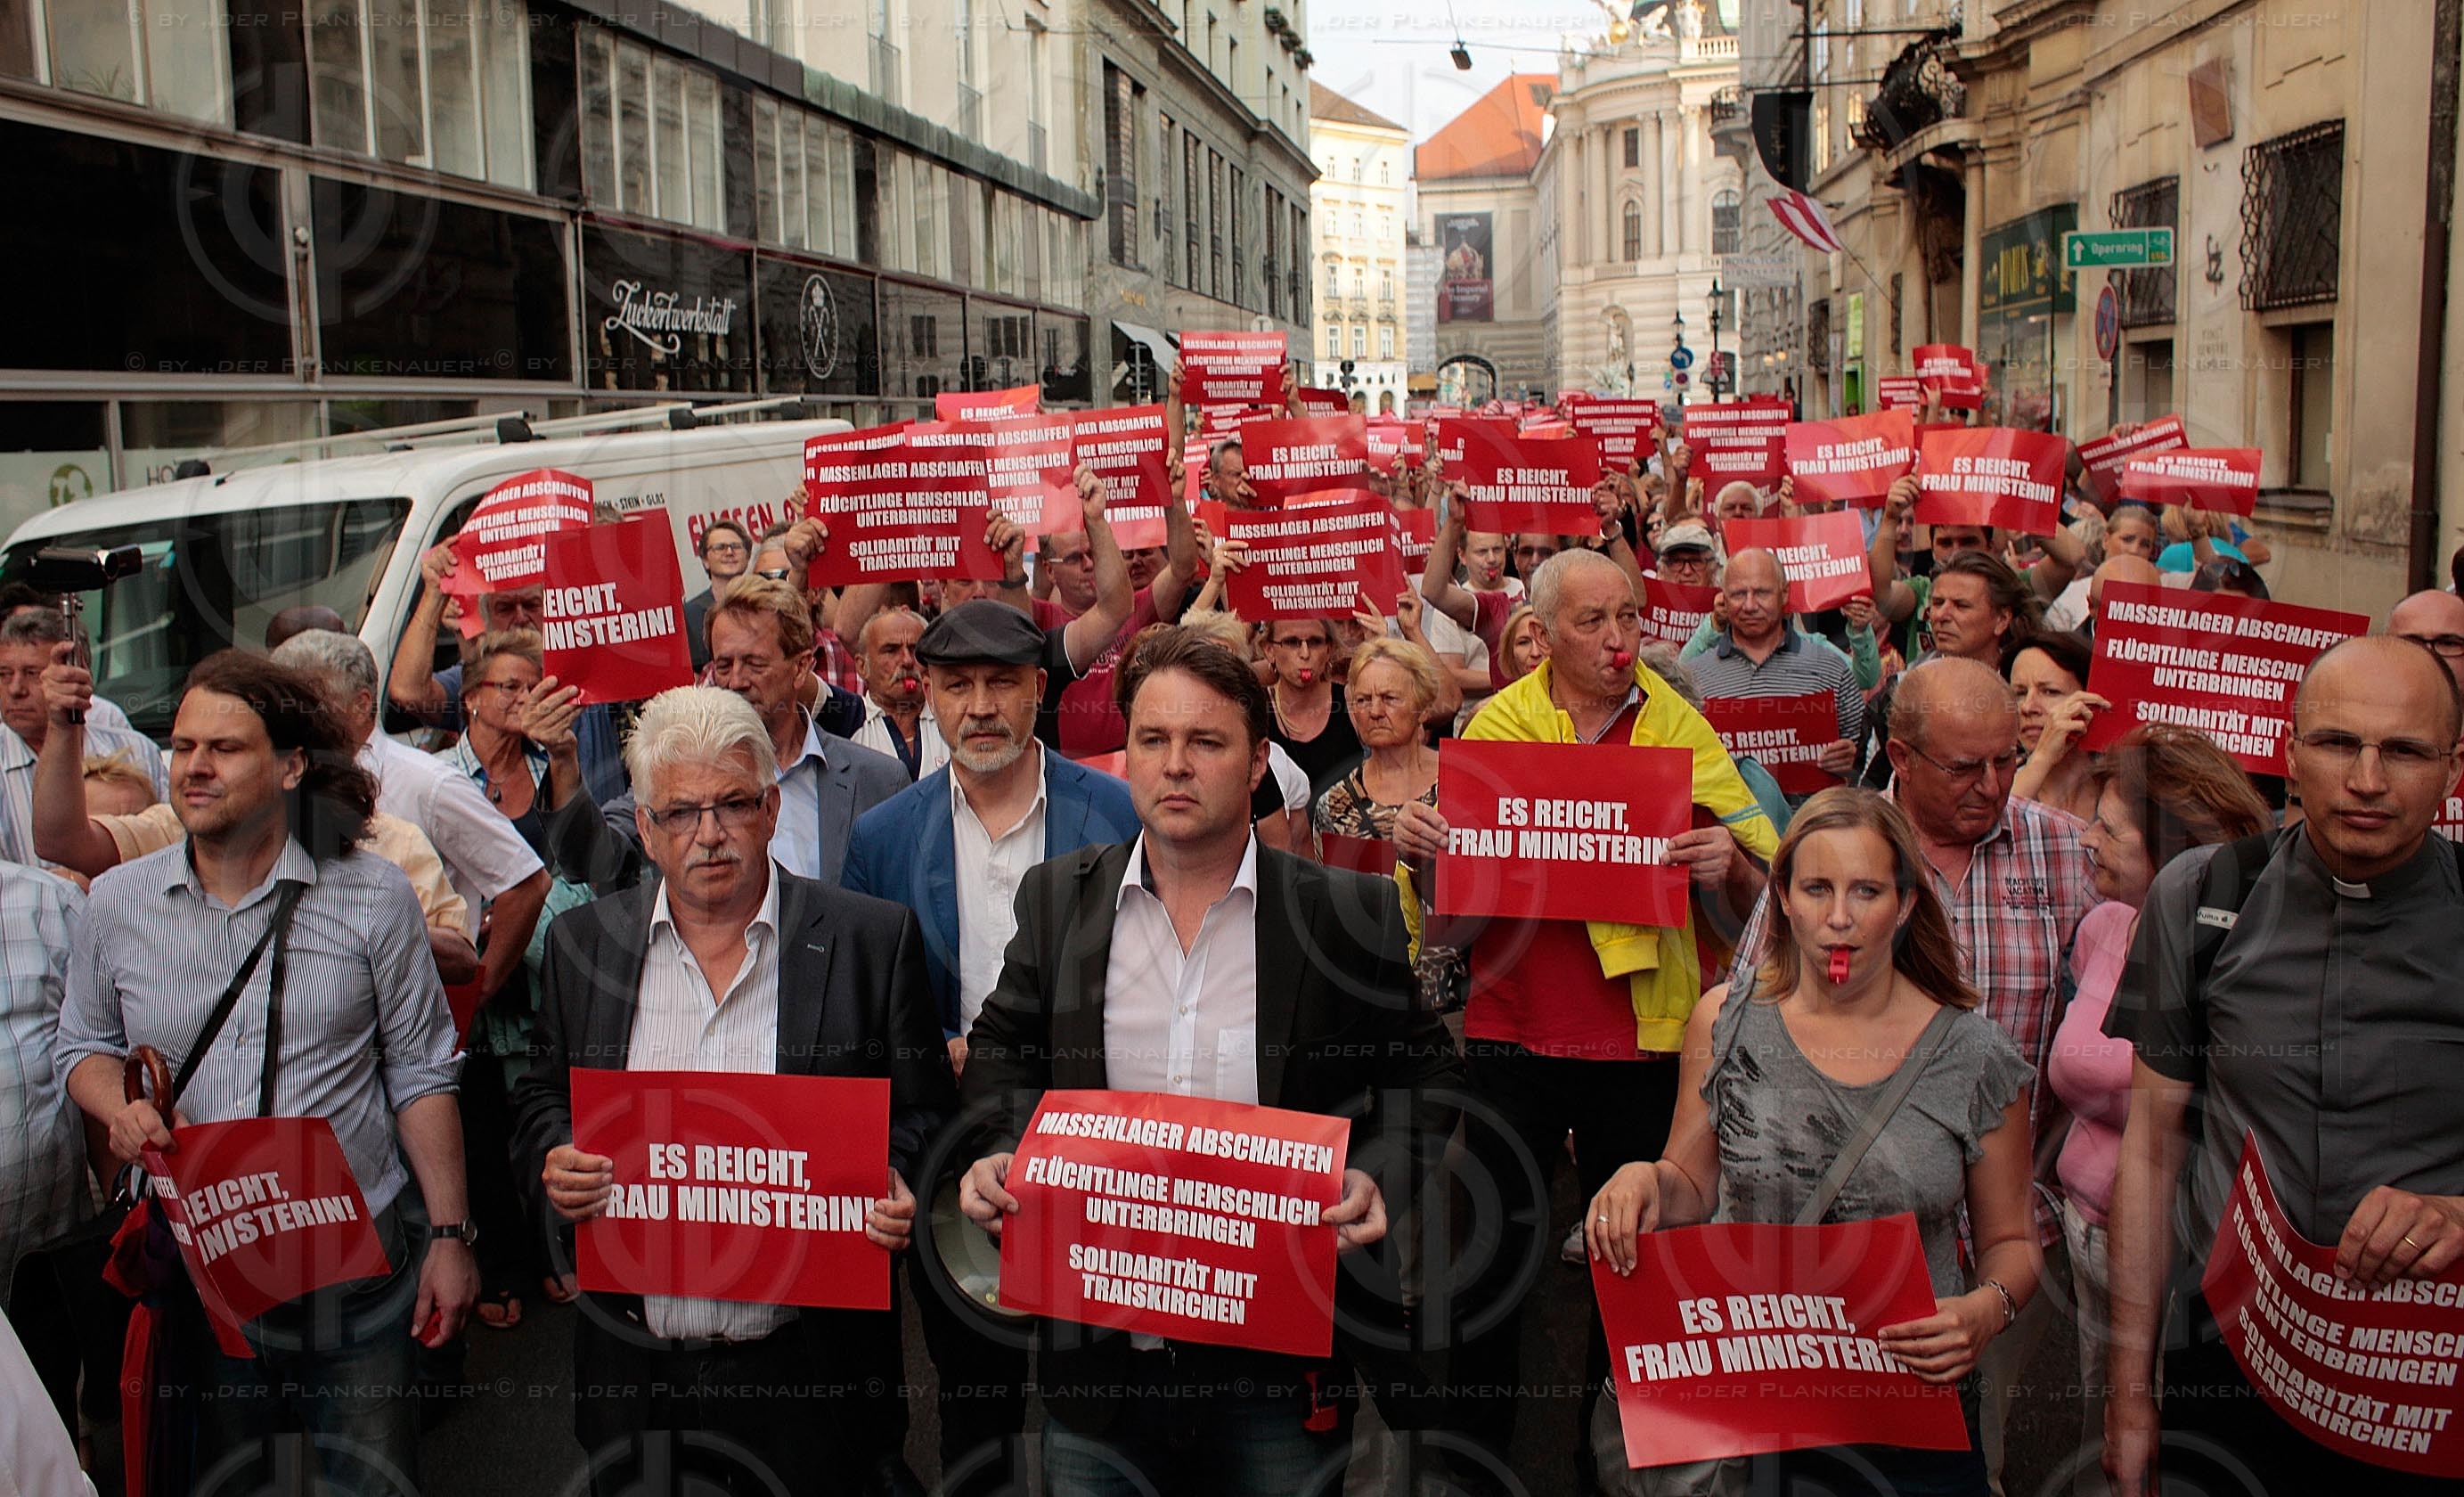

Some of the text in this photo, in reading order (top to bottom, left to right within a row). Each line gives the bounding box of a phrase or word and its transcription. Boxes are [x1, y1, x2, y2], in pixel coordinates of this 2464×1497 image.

[997, 425, 1070, 446] ABSCHAFFEN
[1099, 415, 1163, 433] ABSCHAFFEN
[1098, 438, 1163, 457] MENSCHLICH
[1272, 444, 1338, 463] ES REICHT,
[1816, 437, 1885, 459] ES REICHT,
[820, 462, 908, 483] MASSENLAGER
[910, 460, 986, 478] ABSCHAFFEN
[994, 452, 1069, 473] MENSCHLICH
[1248, 462, 1282, 480] FRAU
[1792, 447, 1911, 475] FRAU MINISTERIN!
[1953, 457, 2030, 481] ES REICHT,
[989, 470, 1040, 488] BRINGEN
[1121, 475, 1140, 488] MIT
[1497, 468, 1570, 487] ES REICHT,
[2166, 464, 2255, 488] MINISTERIN!
[522, 480, 589, 503] ABSCHAFFEN
[820, 493, 903, 513] FLÜCHTLINGE
[905, 489, 989, 508] MENSCHLICH
[1470, 486, 1592, 503] FRAU MINISTERIN
[1921, 474, 2055, 504] FRAU MINISTERIN!
[517, 503, 589, 524] MENSCHLICH
[619, 495, 641, 511] STEIN
[646, 492, 665, 507] GLAS
[1022, 495, 1044, 510] MIT
[856, 508, 958, 528] UNTERBRINGEN
[1229, 519, 1311, 539] MASSENLAGER
[1312, 511, 1385, 534] ABSCHAFFEN
[478, 519, 560, 544] UNTERBRINGEN
[475, 544, 538, 570] SOLIDARITÄT
[849, 535, 961, 557] SOLIDARITÄT MIT
[1310, 537, 1384, 560] MENSCHLICH
[483, 559, 545, 582] TRAISKIRCH
[858, 552, 956, 572] TRAISKIRCHEN
[1268, 556, 1356, 576] UNTERBRINGEN
[1783, 556, 1862, 581] INISTERIN!
[1262, 580, 1359, 598] SOLIDARITÄT MIT
[1271, 593, 1356, 610] TRAISKIRCHEN
[1640, 617, 1659, 635] RAU
[1652, 606, 1668, 623] ES
[2108, 601, 2234, 635] MASSENLAGER
[543, 606, 676, 651] INISTERIN!
[2107, 638, 2306, 683] FLÜCHTLINGE MENSCHL
[2153, 667, 2286, 702] UNTERBRINGEN
[2136, 700, 2285, 739] SOLIDARITÄT MIT
[1737, 728, 1799, 748] REICHT,
[1497, 797, 1629, 833] ES REICHT,
[1448, 827, 1670, 866] FRAU MINISTERIN
[1035, 1110, 1334, 1174] MASSENLAGER ABSCHAFFEN
[649, 1143, 811, 1192] ES REICHT,
[606, 1184, 668, 1221] RAU
[1025, 1155, 1320, 1226] FLÜCHTLINGE MENSCHLICH
[196, 1195, 358, 1266] INISTERIN!
[1085, 1196, 1256, 1249] UNTERBRINGEN
[1069, 1243, 1258, 1299] SOLIDARITÄT MIT
[2233, 1203, 2345, 1344] FLÜCHTLINGE
[1081, 1272, 1245, 1325] TRAISKIRCHEN
[1679, 1294, 1856, 1335] ES REICHT,
[2255, 1287, 2458, 1387] UNTERBRINGEN
[1624, 1338, 1713, 1384] FRAU
[2239, 1305, 2452, 1431] SOLIDARITÄT MIT
[2243, 1336, 2432, 1455] TRAISKIRCHEN
